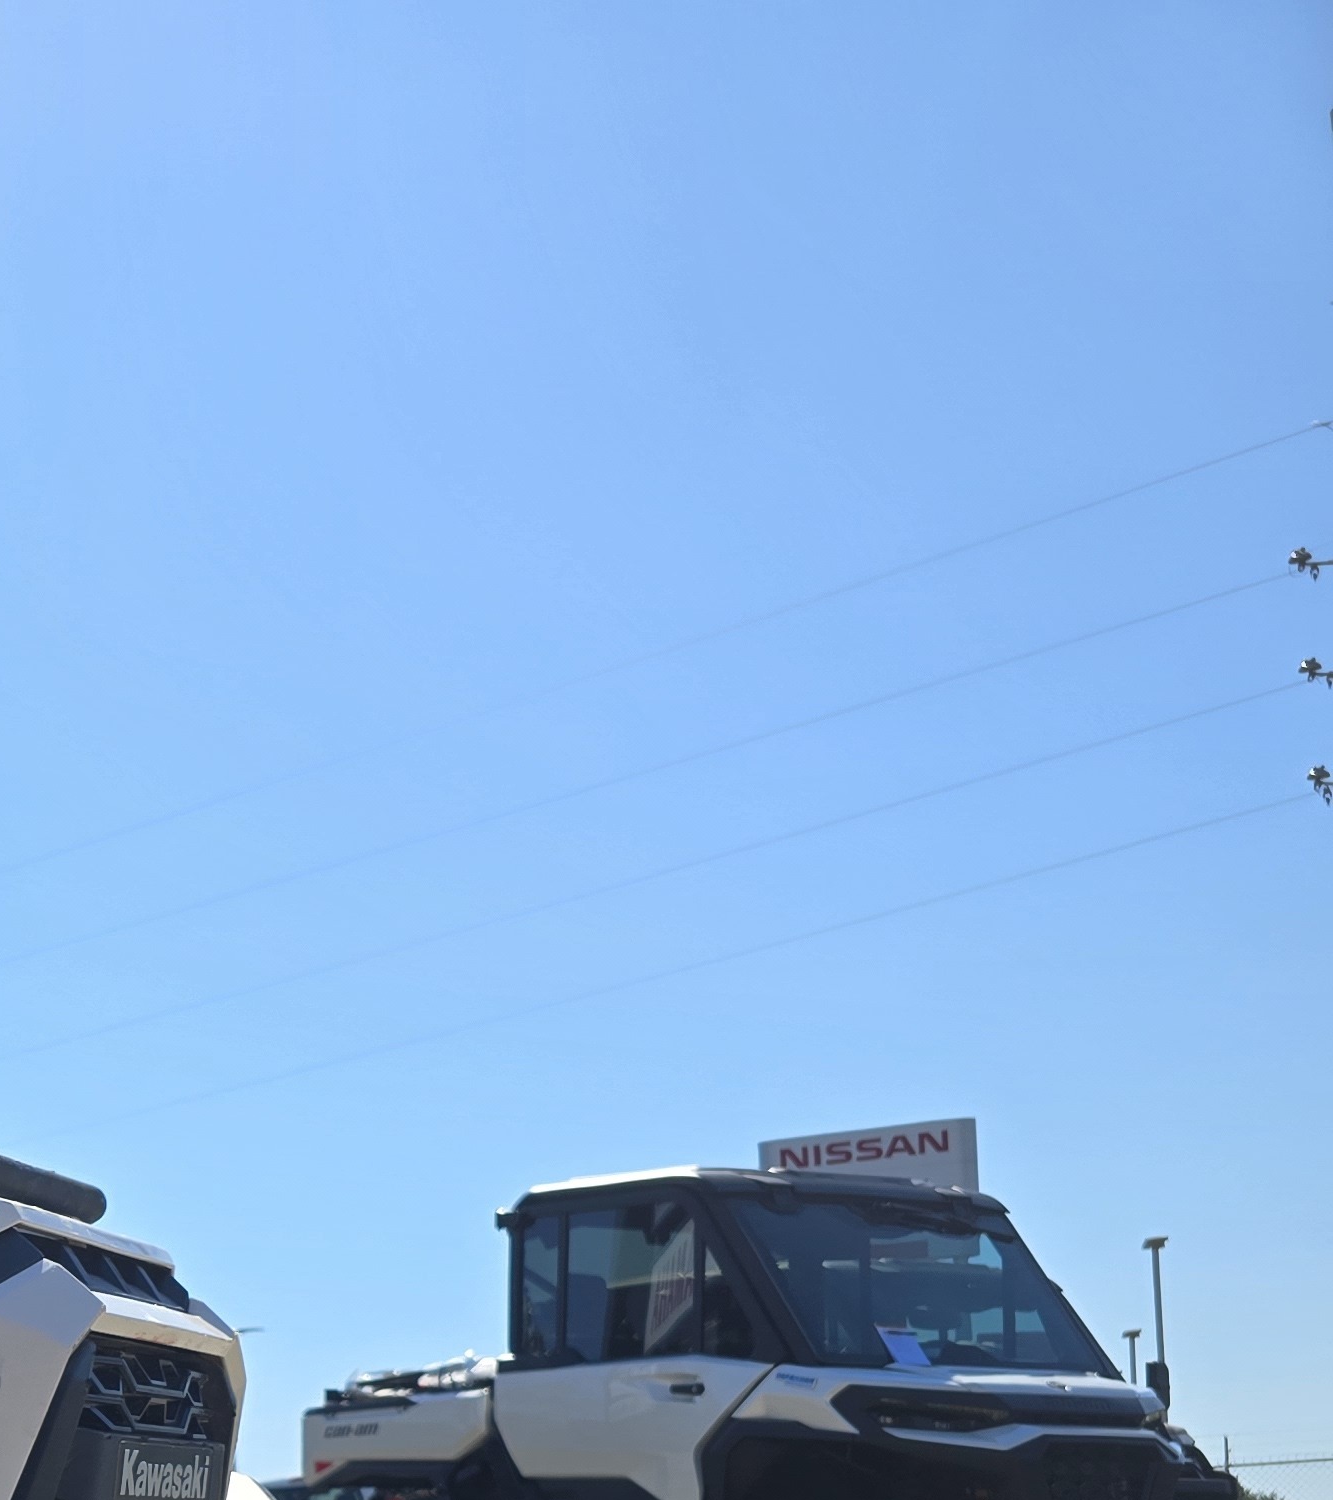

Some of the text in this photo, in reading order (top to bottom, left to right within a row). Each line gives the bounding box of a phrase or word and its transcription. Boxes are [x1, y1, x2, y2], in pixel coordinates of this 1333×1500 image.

[779, 1128, 949, 1169] NISSAN
[323, 1421, 380, 1439] can-am
[119, 1448, 210, 1499] Kawasaki
